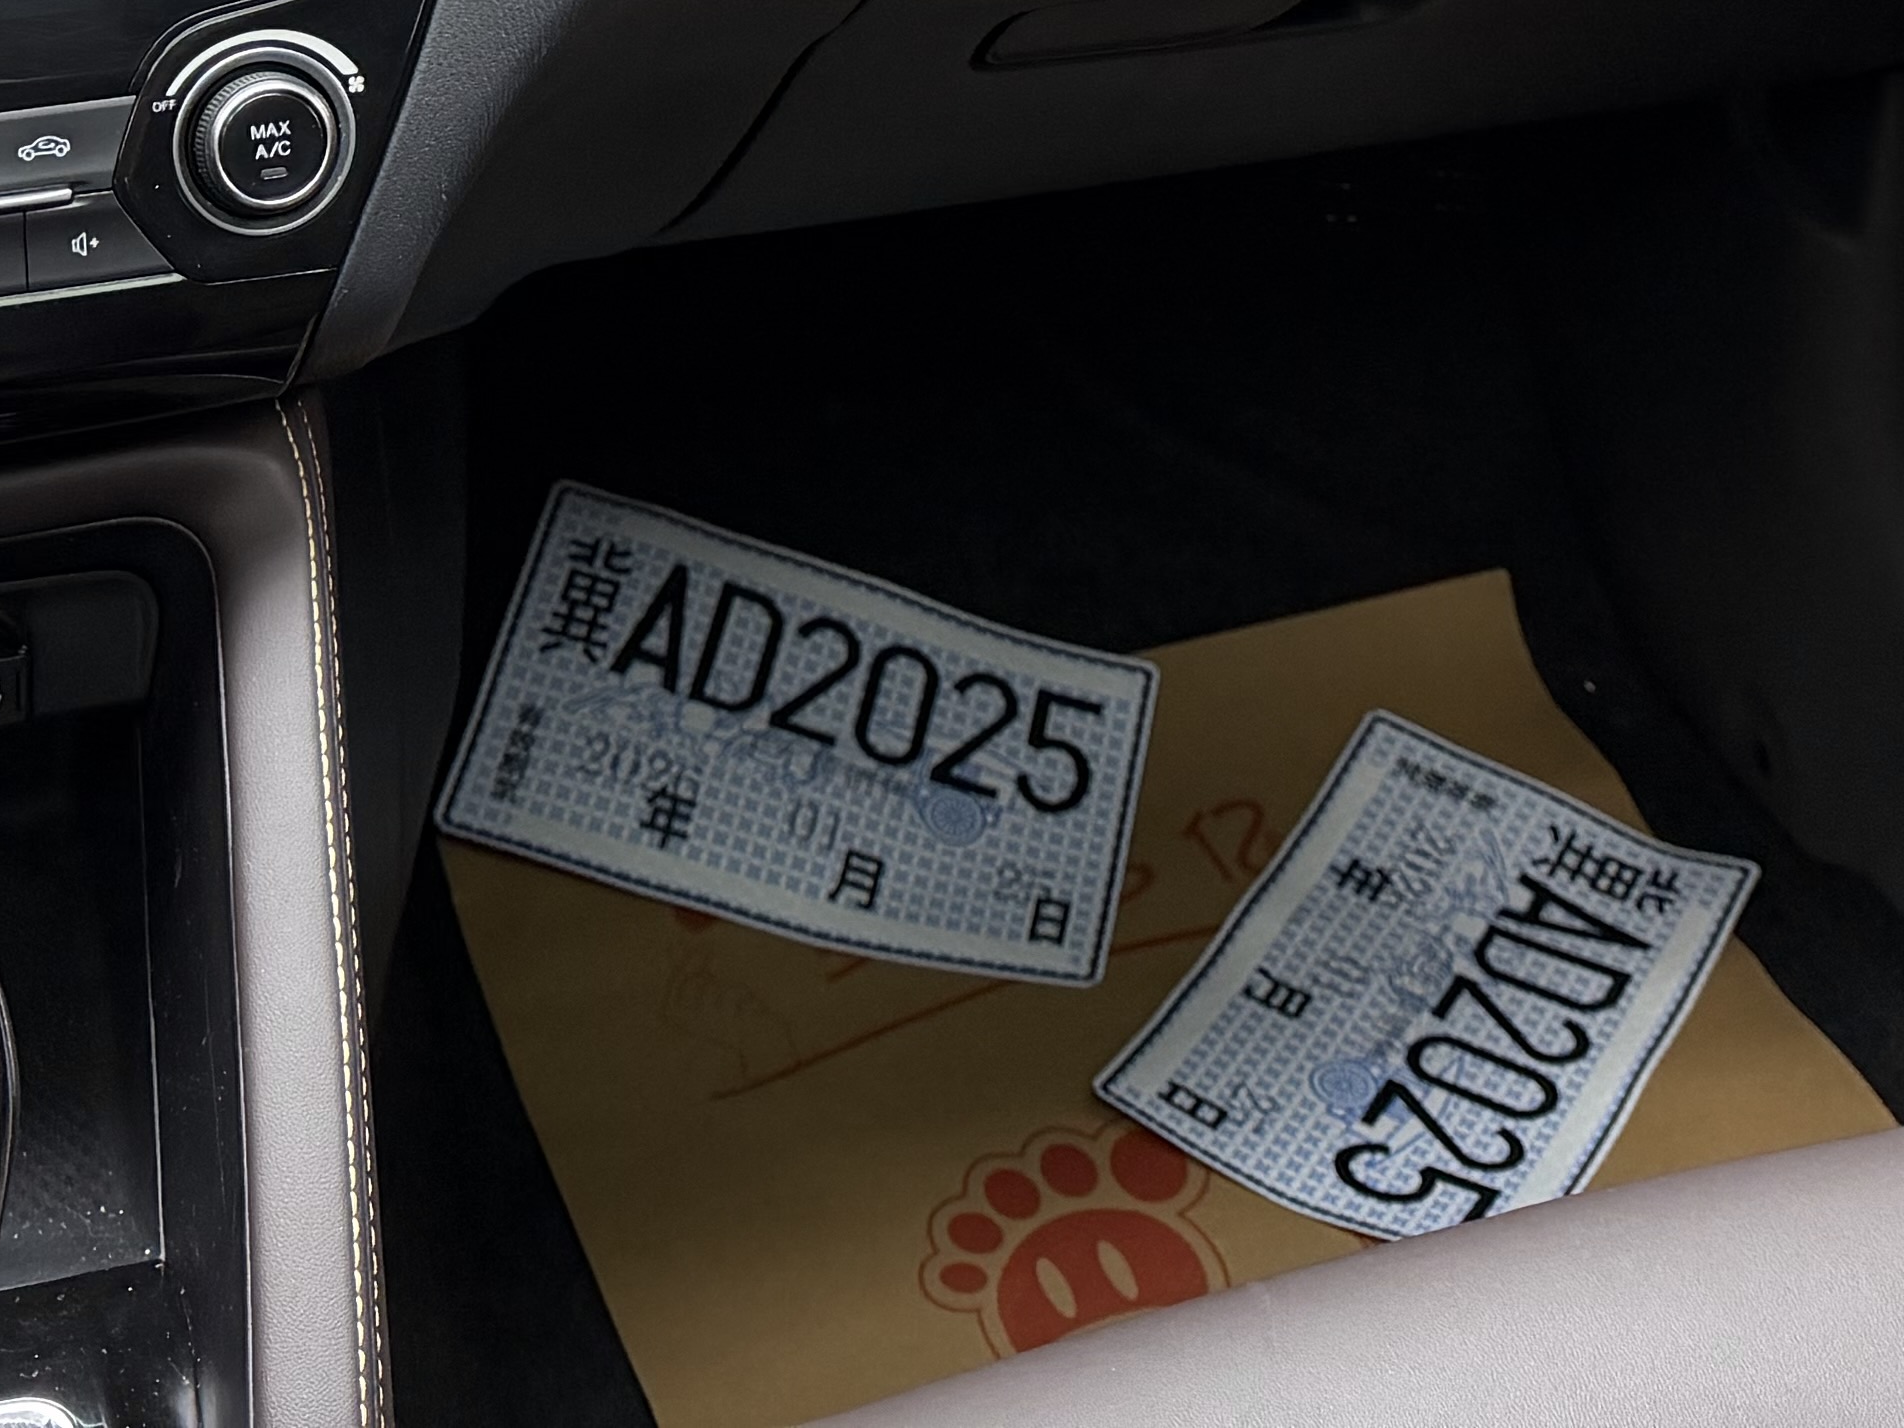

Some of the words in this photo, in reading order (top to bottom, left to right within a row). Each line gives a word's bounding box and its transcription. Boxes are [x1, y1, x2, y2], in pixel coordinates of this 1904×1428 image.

[151, 99, 177, 113] OFF
[250, 120, 292, 141] MAX
[255, 140, 292, 161] A/C
[539, 536, 1104, 814] 冀AD2025
[638, 784, 698, 849] 年
[827, 848, 883, 910] 月
[1028, 896, 1071, 945] 日
[1328, 857, 1395, 903] 年
[1239, 965, 1313, 1020] 月
[1333, 825, 1680, 1224] 冀AD2025
[1155, 1079, 1229, 1131] 日
